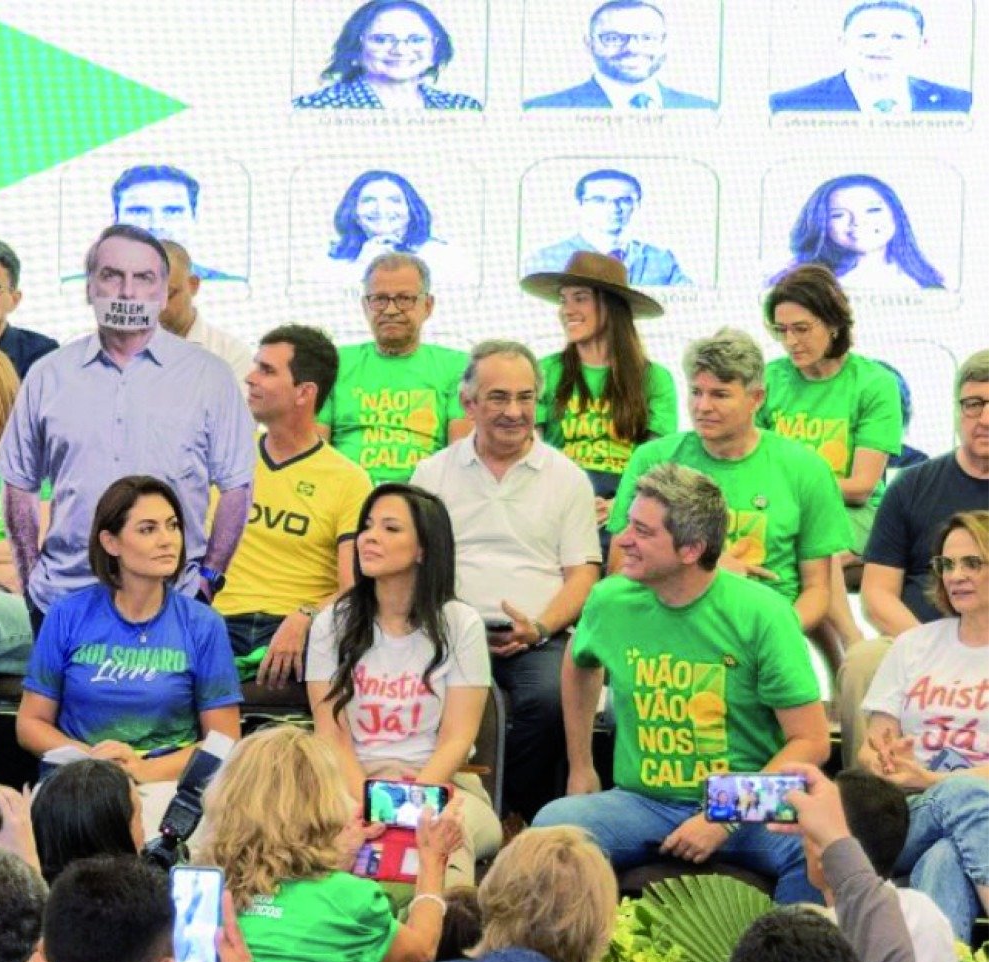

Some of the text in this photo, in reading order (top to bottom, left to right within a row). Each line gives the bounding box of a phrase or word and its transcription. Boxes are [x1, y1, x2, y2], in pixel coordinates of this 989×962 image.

[105, 312, 126, 326] POR
[361, 387, 409, 411] NÃO
[775, 411, 824, 441] NÃO
[635, 653, 693, 690] NÃO
[632, 689, 688, 724] VÃO
[638, 727, 694, 755] NOS
